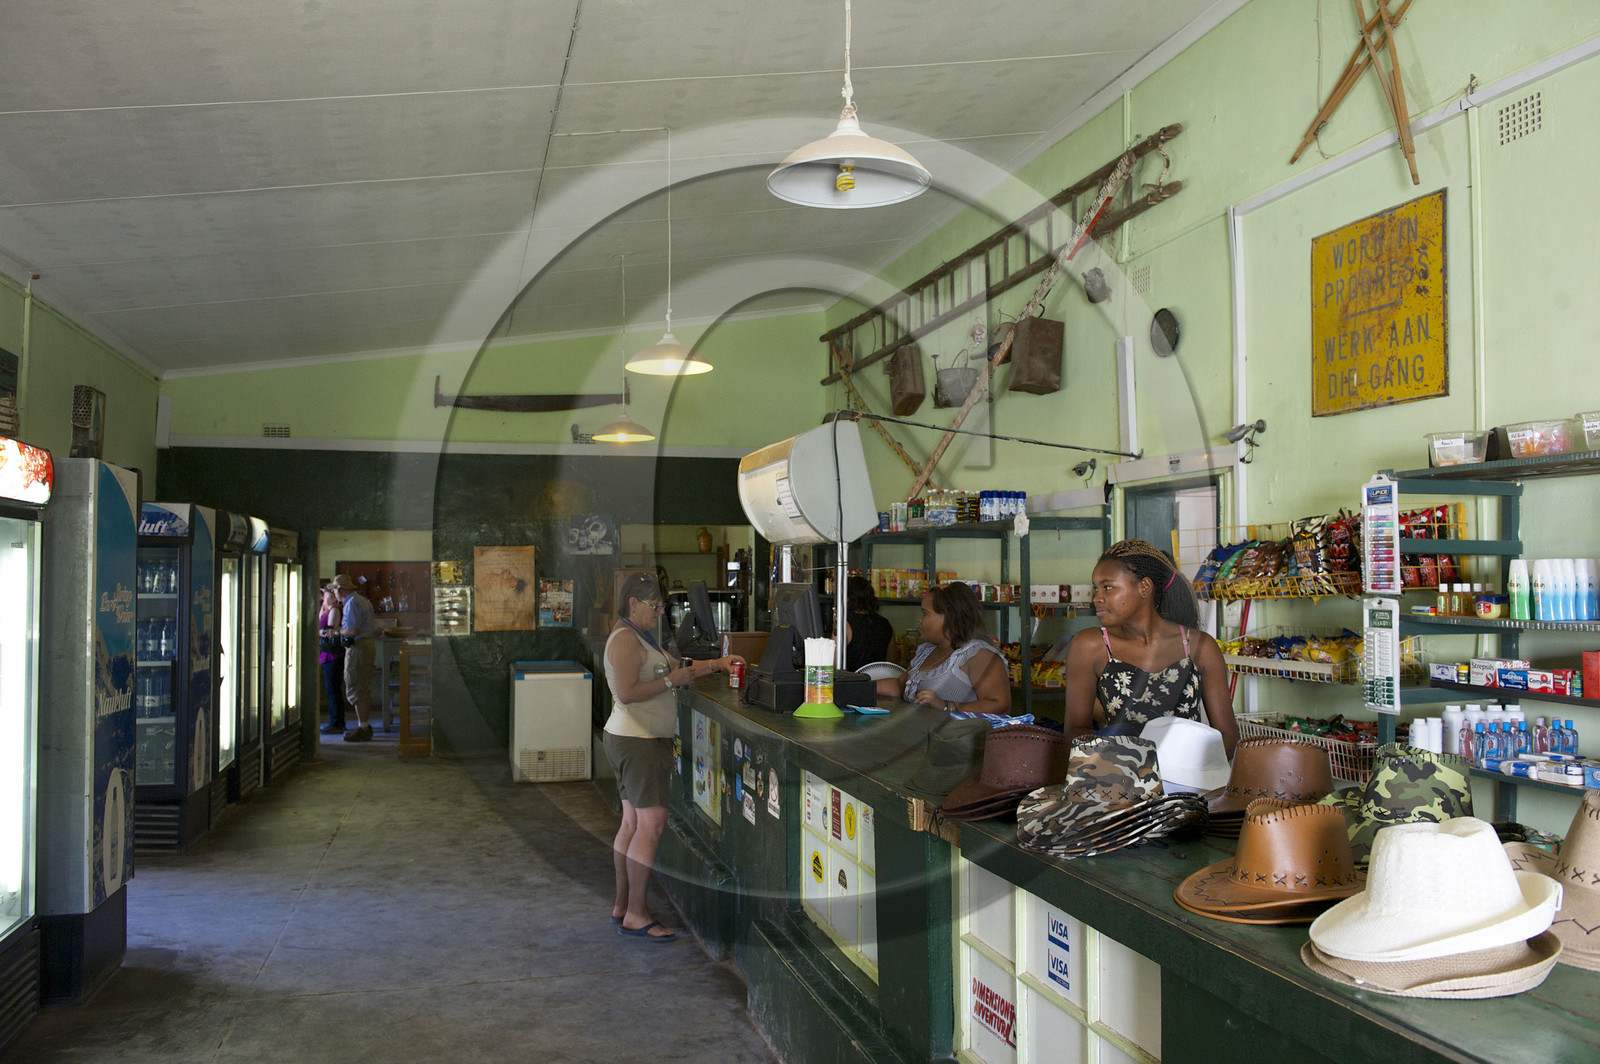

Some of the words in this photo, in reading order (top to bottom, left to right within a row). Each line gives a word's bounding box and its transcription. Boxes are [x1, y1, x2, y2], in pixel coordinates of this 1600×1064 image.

[1332, 231, 1384, 270] WORK
[1397, 214, 1419, 249] IN
[1323, 252, 1430, 309] PROGRESS
[1324, 327, 1375, 363] WERK
[1389, 312, 1430, 349] AAN
[1328, 367, 1357, 399] DIE
[1370, 354, 1425, 391] GANG
[1471, 663, 1495, 671] Strepsils
[1501, 673, 1523, 682] DISPRIN
[1050, 917, 1069, 940] VISA
[1050, 954, 1069, 978] VISA
[972, 977, 1015, 1022] DIMENSIONE
[973, 999, 1010, 1037] AVVENTURA
